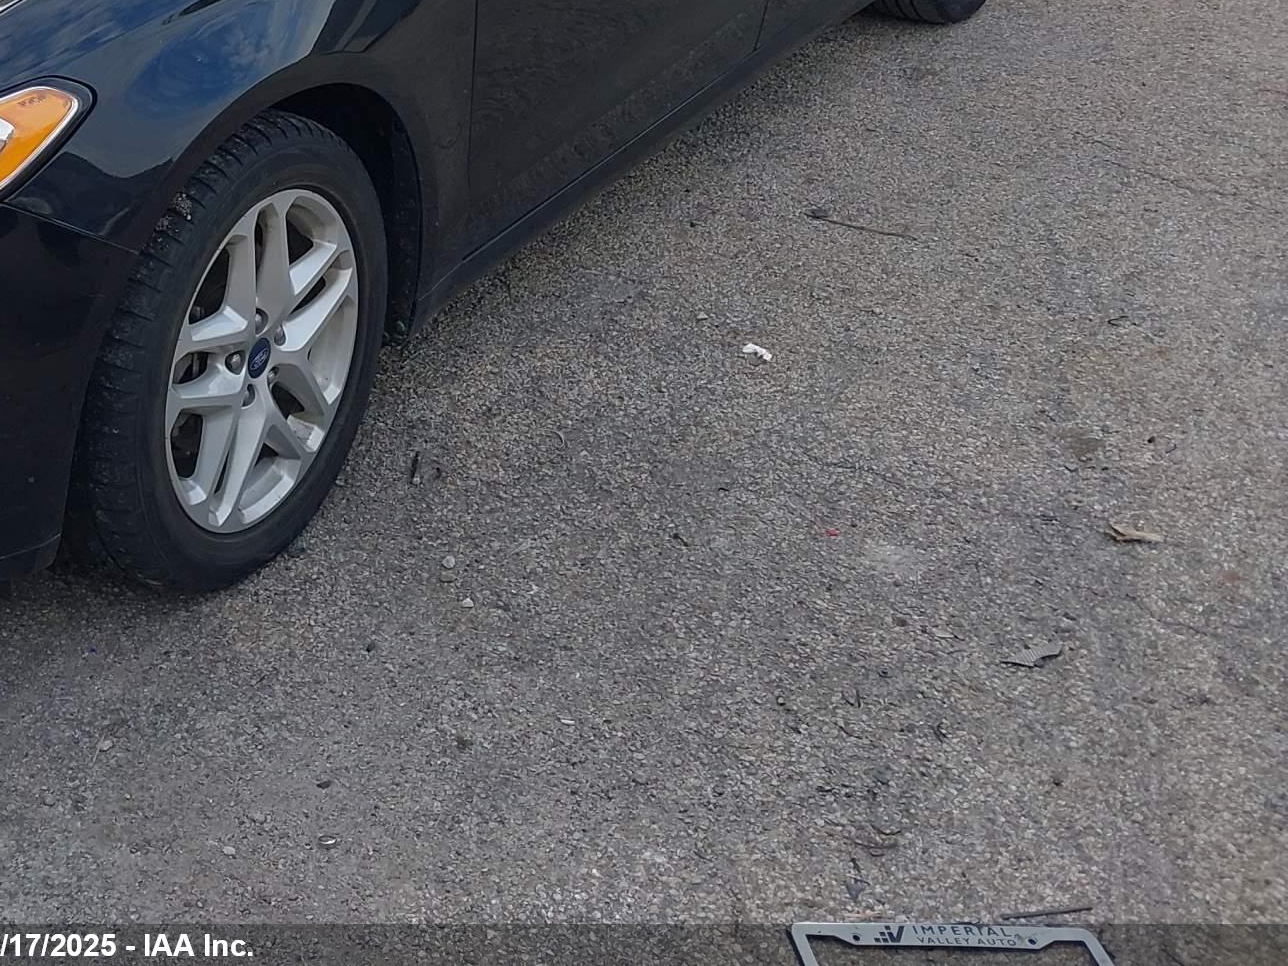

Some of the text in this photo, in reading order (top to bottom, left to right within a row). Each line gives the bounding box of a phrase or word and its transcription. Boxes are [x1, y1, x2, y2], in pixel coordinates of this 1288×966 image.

[912, 925, 1011, 938] IMPERIAL
[917, 937, 1017, 947] VALLEY AUTO
